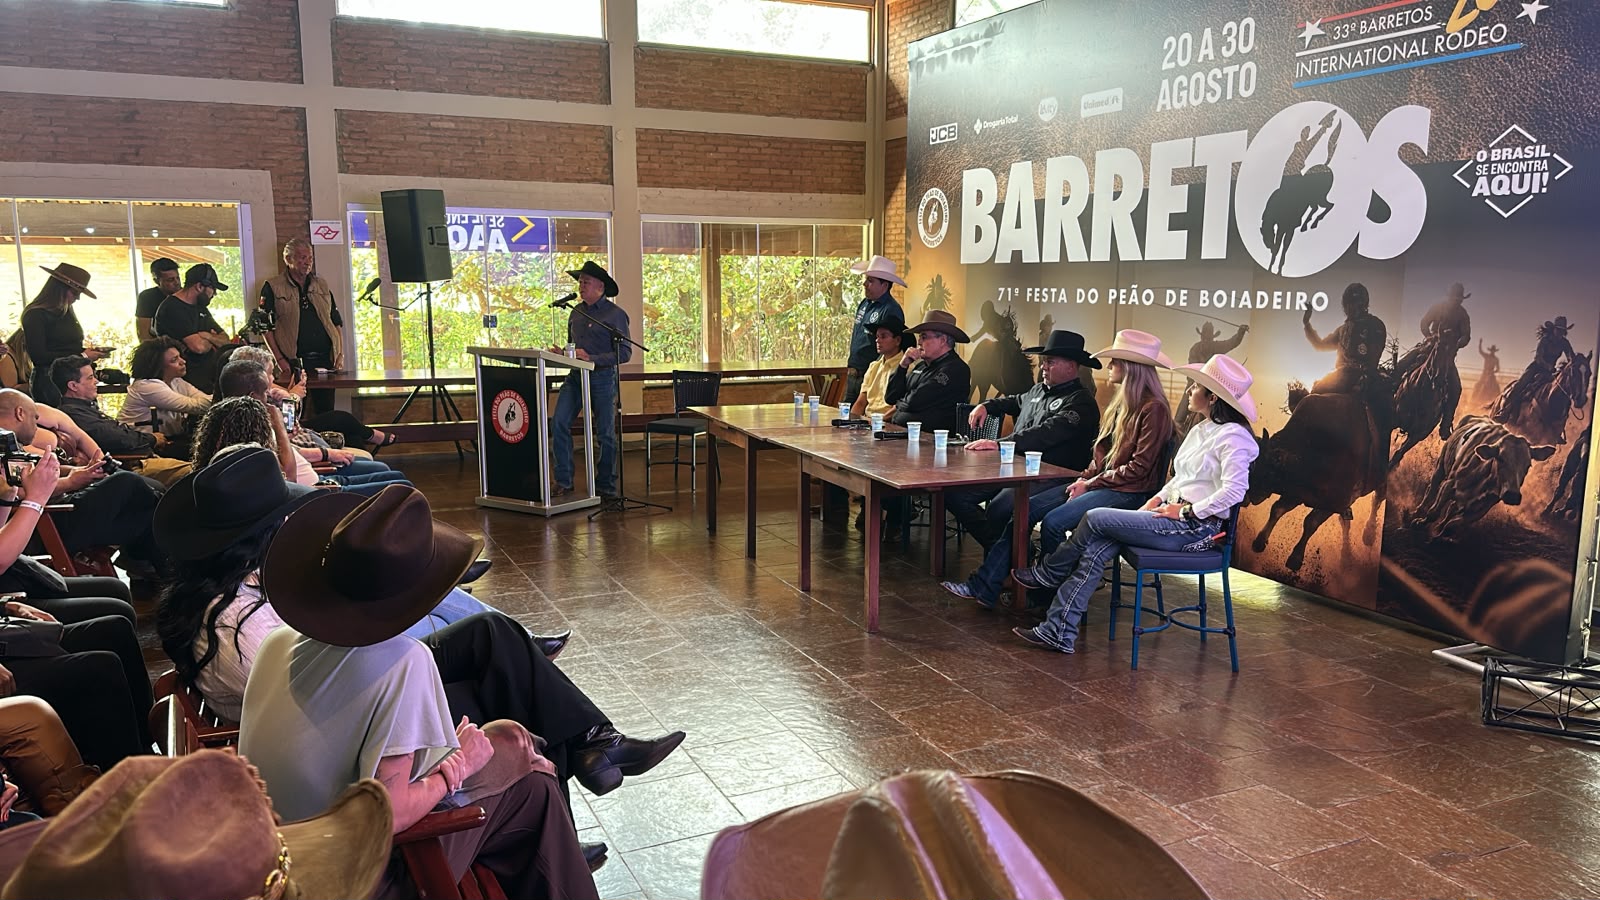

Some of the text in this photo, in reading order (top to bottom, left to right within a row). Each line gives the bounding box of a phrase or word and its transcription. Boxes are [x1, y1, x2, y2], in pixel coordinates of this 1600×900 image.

[1359, 6, 1433, 33] BARRETOS
[1162, 17, 1255, 70] 20 A 30
[1295, 23, 1507, 78] INTERNATIONAL RODEO
[1156, 61, 1257, 112] AGOSTO
[930, 124, 957, 144] JCB
[1475, 159, 1549, 175] SE ENCONTRA
[1476, 144, 1551, 163] O BRASIL
[960, 101, 1431, 277] BARRETOS
[1472, 172, 1549, 197] AQUI!
[1026, 287, 1068, 304] FESTA
[1076, 288, 1099, 304] DO
[1108, 284, 1155, 306] PEÃO
[1165, 289, 1188, 306] DE
[1199, 289, 1329, 312] BOIADEIRO
